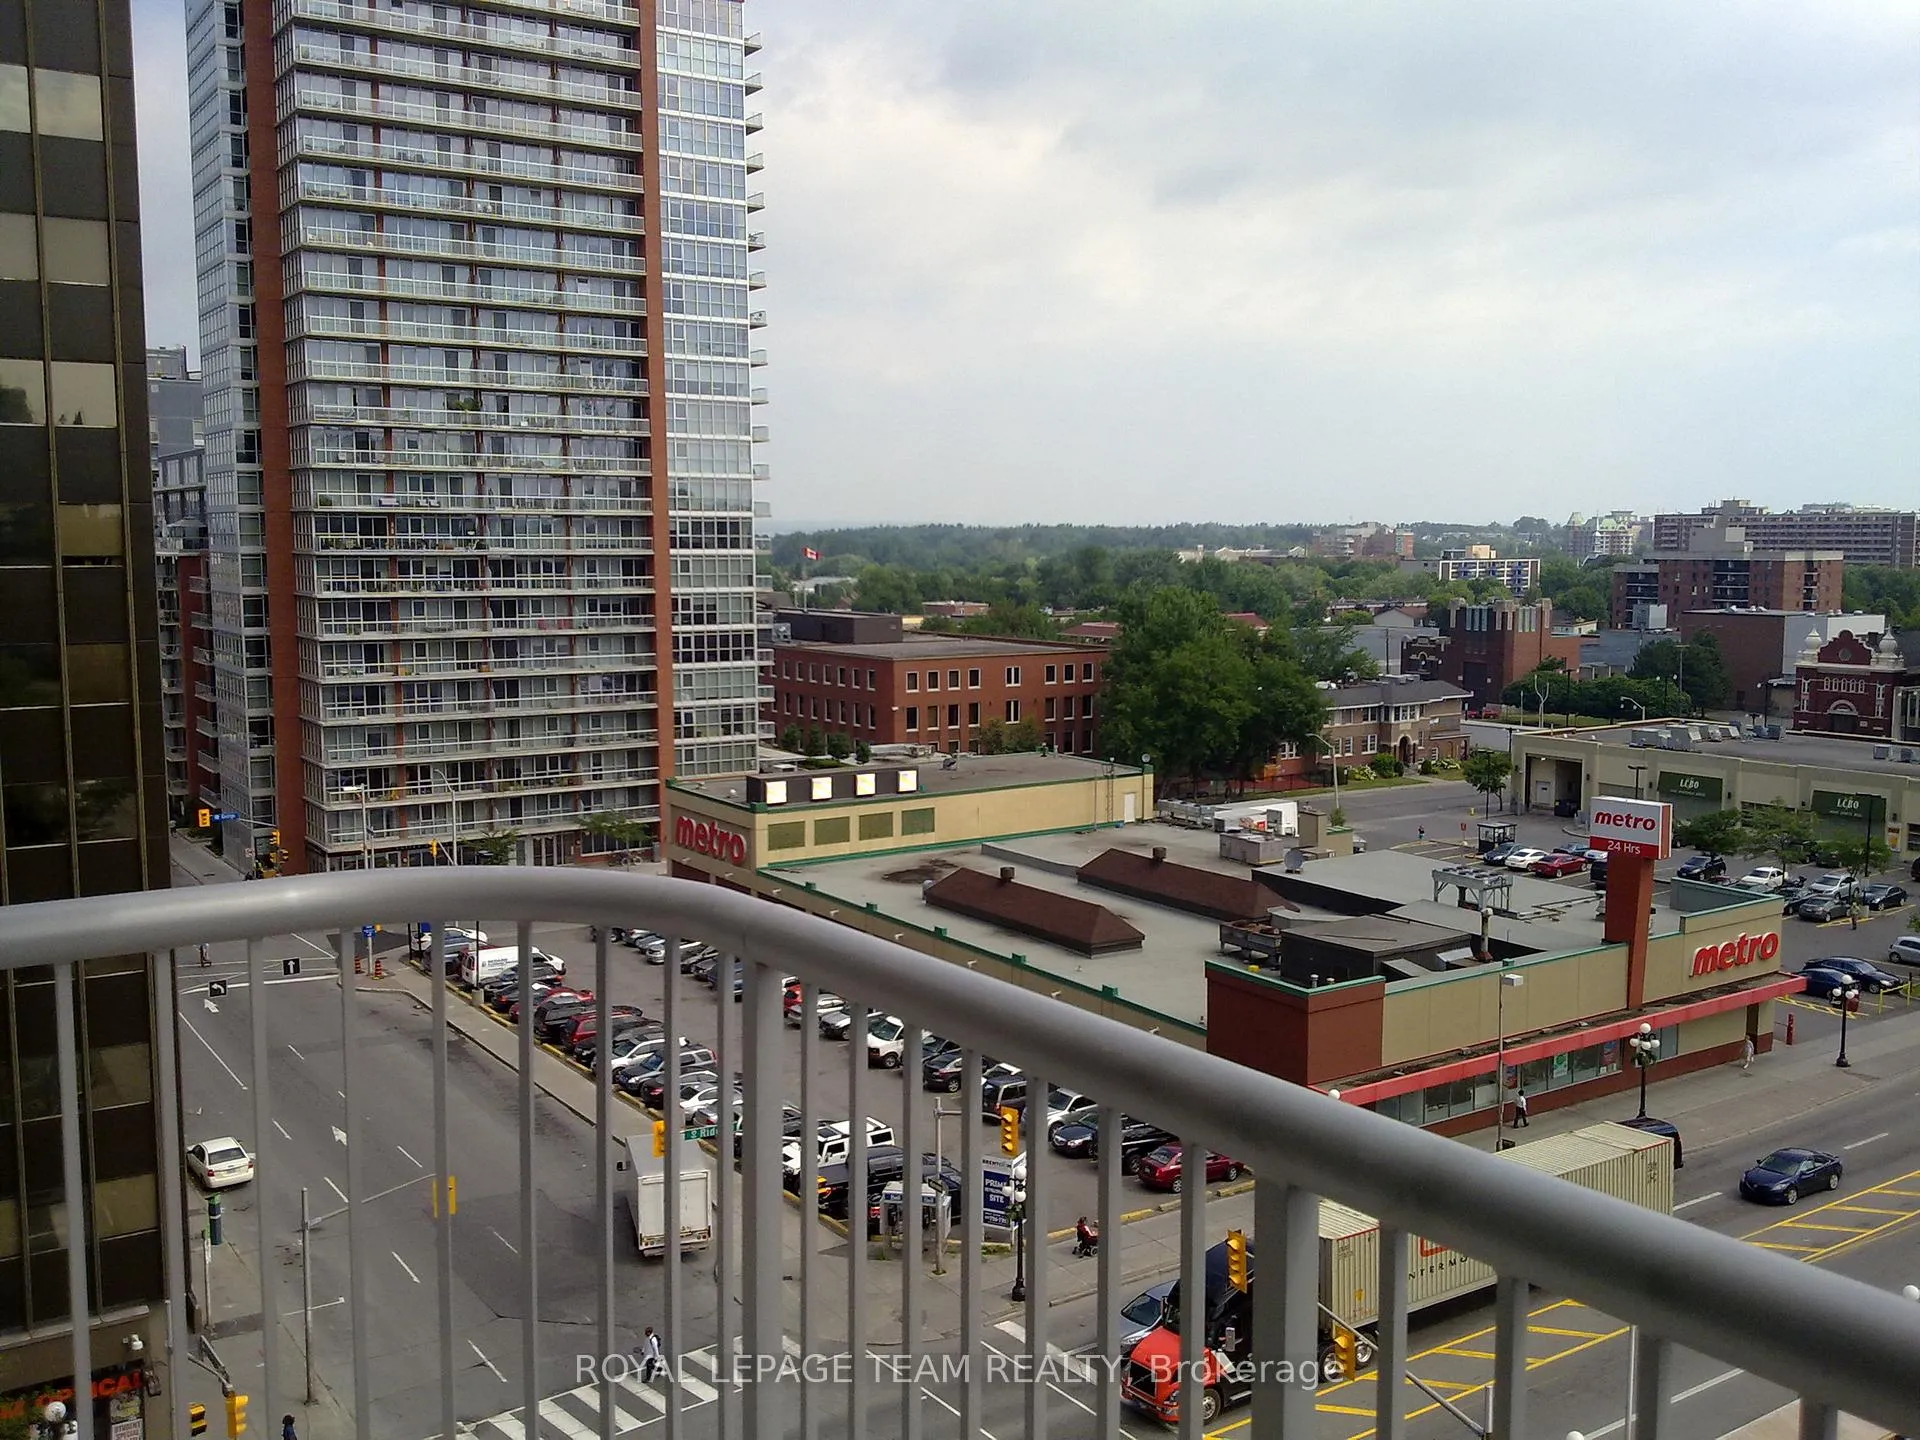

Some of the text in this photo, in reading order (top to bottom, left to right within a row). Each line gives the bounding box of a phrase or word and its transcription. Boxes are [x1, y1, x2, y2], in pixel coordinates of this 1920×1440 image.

[1679, 778, 1700, 789] LCBO
[1836, 797, 1860, 809] LCBO
[1594, 811, 1656, 831] metro
[675, 815, 747, 866] metro
[1607, 840, 1641, 855] 24 Hrs
[1691, 931, 1779, 977] metro
[989, 1194, 1005, 1203] SITE
[36, 1369, 141, 1408] OPICAL
